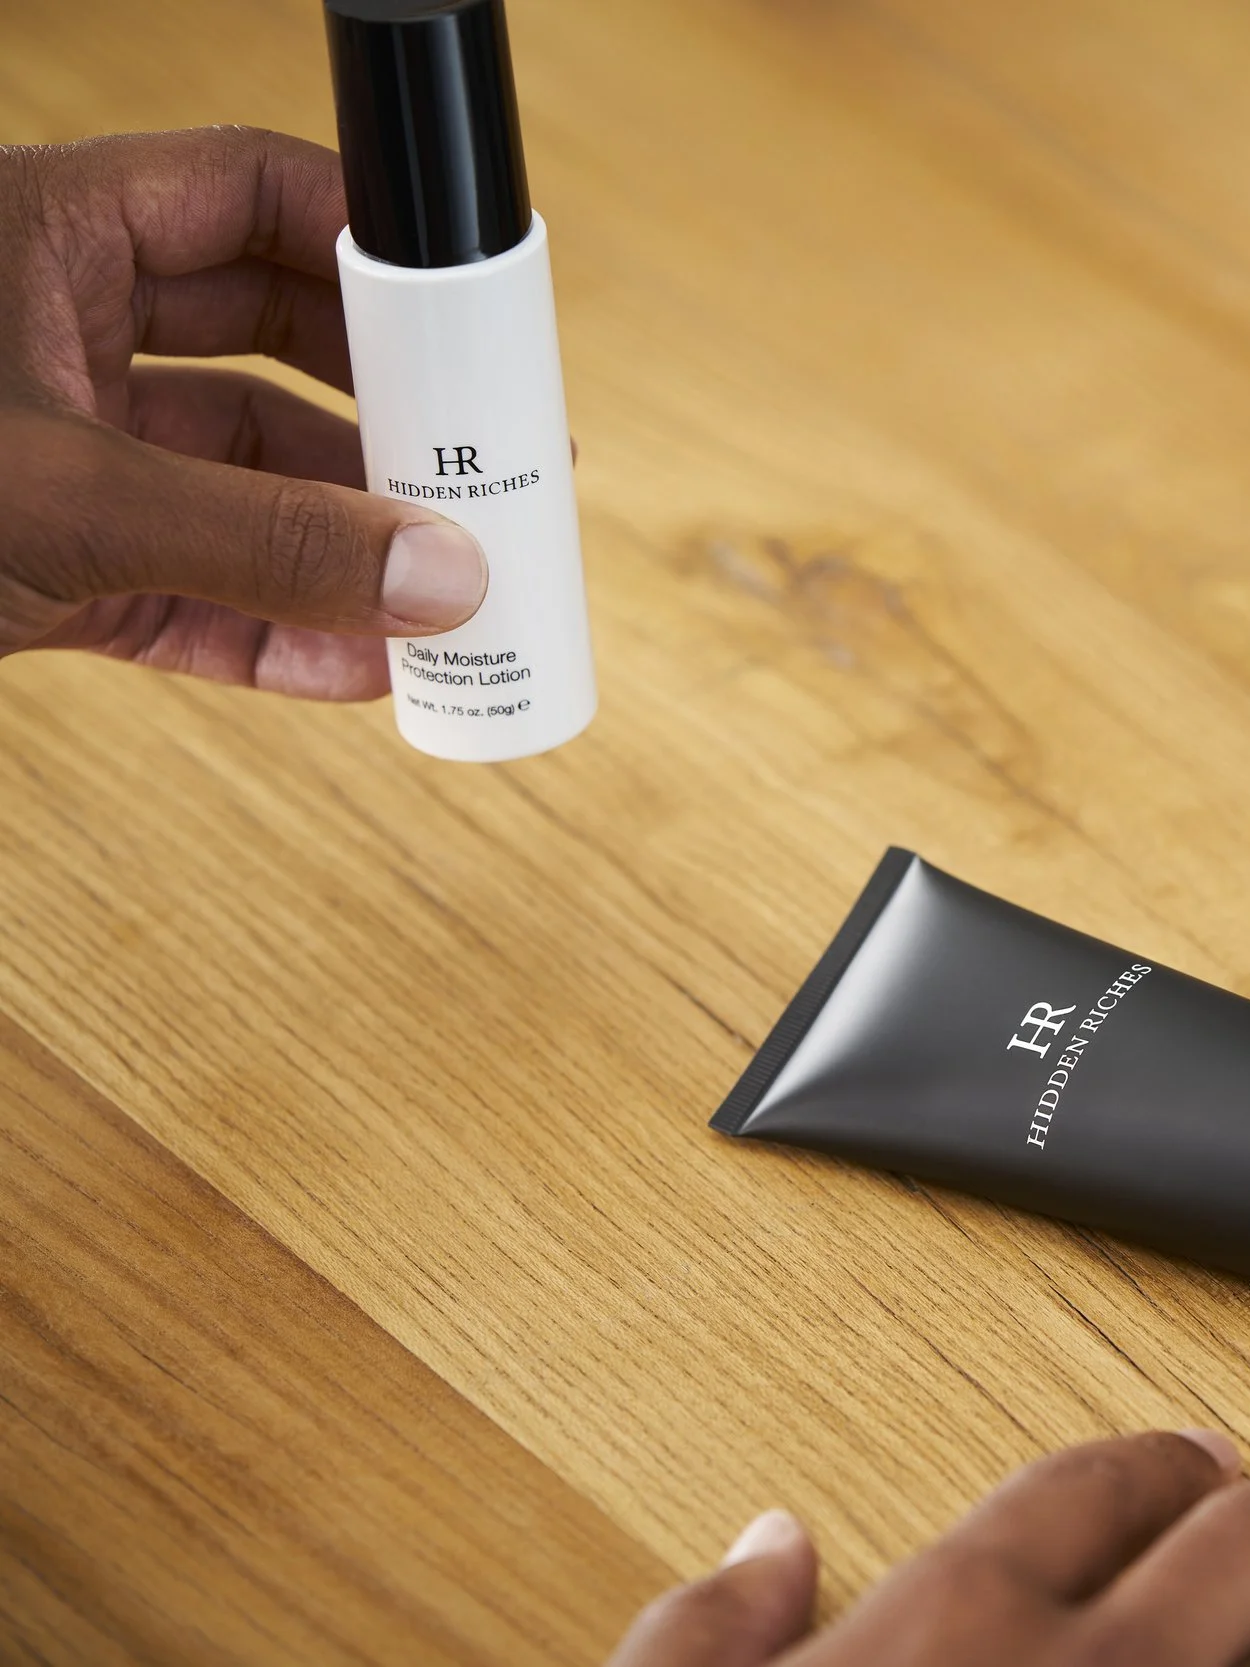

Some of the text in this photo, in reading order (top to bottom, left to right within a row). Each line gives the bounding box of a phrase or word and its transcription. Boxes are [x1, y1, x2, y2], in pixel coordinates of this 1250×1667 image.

[432, 445, 483, 476] HR
[388, 469, 540, 499] HIDDEN RICHES
[407, 642, 517, 666] Daily Moisture
[401, 658, 531, 686] Protection Lotion
[441, 705, 464, 716] 1.75
[467, 708, 484, 717] oz.
[487, 704, 515, 717] (50g)
[1006, 1002, 1077, 1059] HR
[1026, 963, 1152, 1150] HIDDEN RICHES
